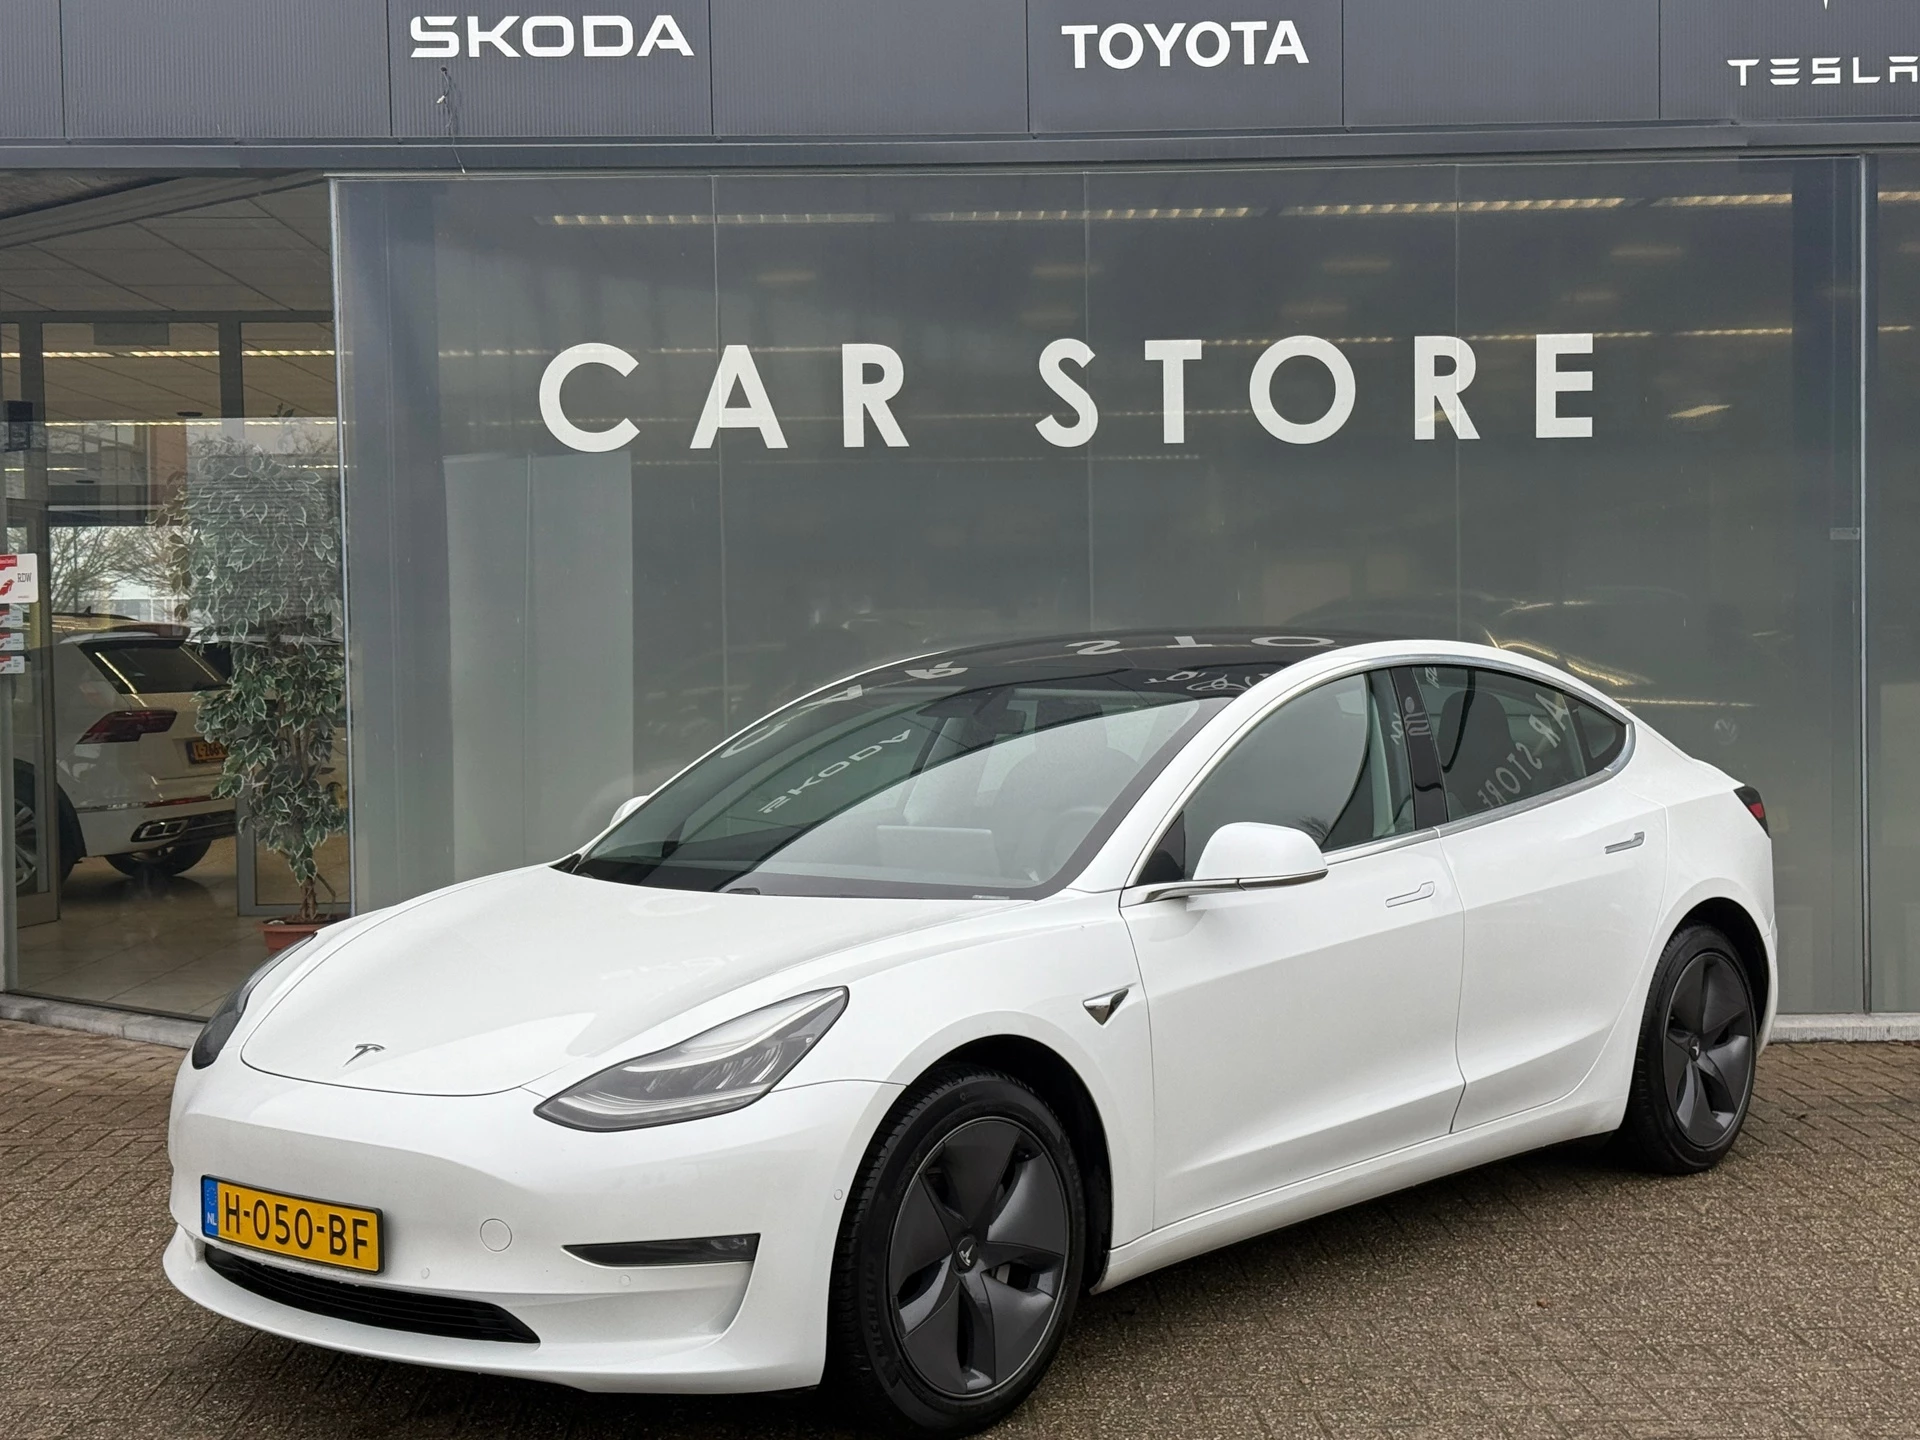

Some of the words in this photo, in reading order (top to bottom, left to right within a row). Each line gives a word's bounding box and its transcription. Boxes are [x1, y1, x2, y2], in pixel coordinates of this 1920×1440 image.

[410, 14, 695, 58] SKODA
[1061, 20, 1310, 70] TOYOTA
[1726, 55, 1920, 87] TESLA
[538, 342, 910, 453] CAR
[1034, 332, 1595, 448] STORE
[207, 1212, 217, 1226] NL
[225, 1191, 369, 1260] H-050-BF
